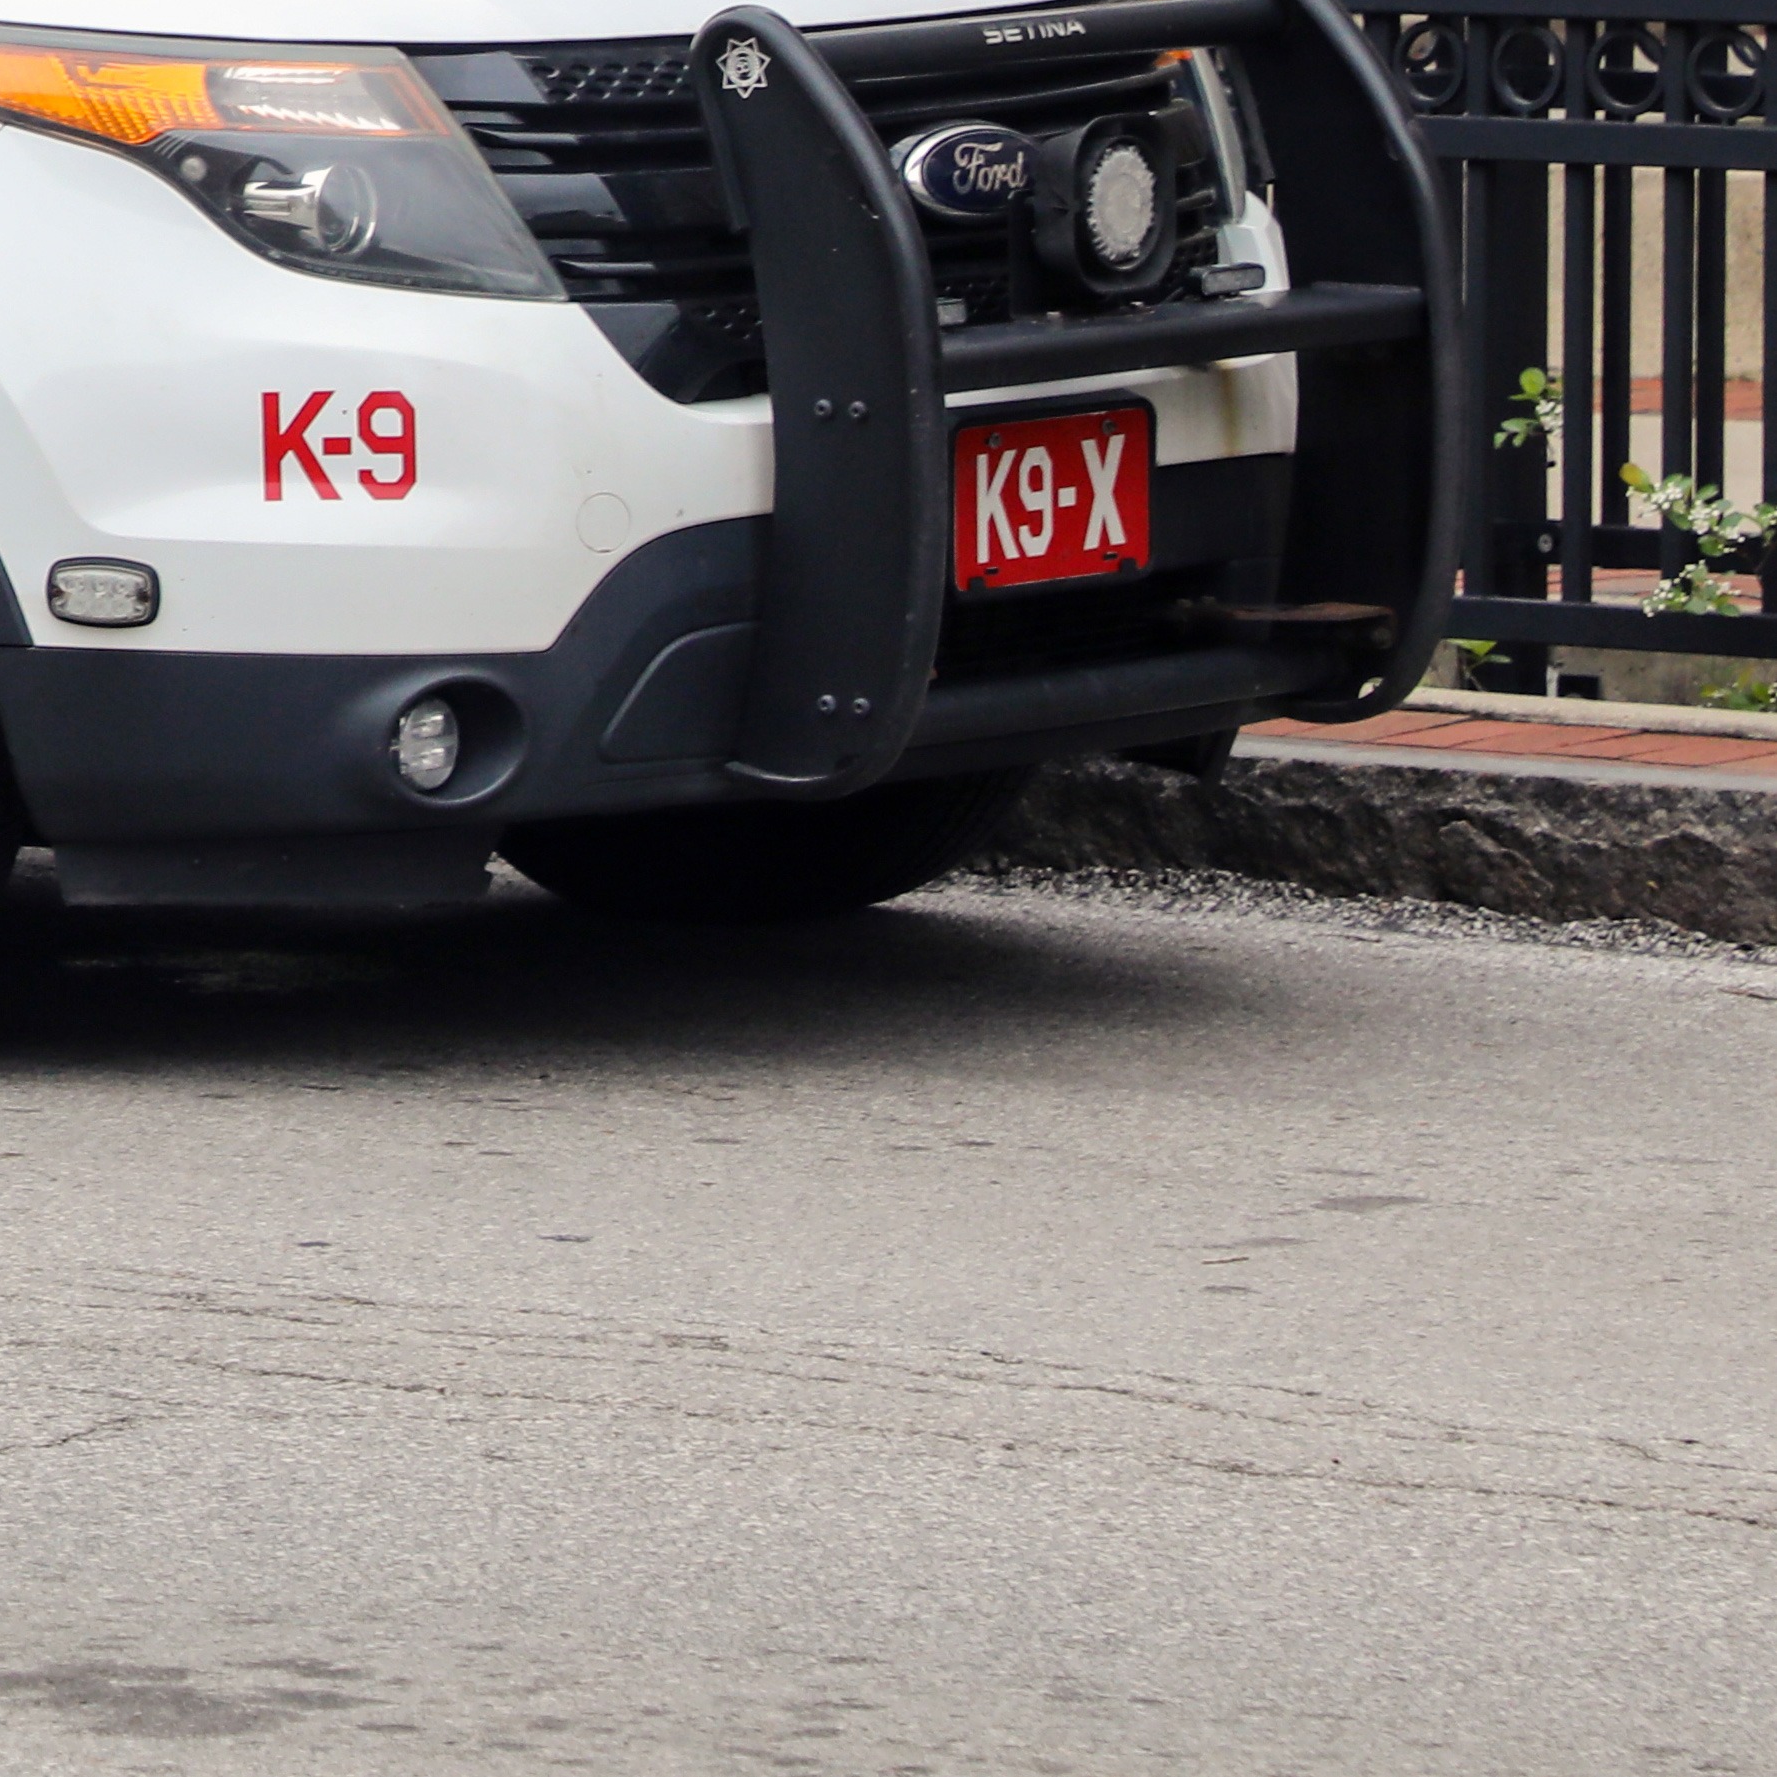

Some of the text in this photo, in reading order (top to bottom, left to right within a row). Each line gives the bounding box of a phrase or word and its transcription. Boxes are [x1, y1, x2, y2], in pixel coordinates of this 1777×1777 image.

[982, 21, 1087, 45] SETINA
[952, 141, 1029, 195] Ford
[261, 391, 417, 502] K-9
[976, 434, 1126, 564] K9-X
